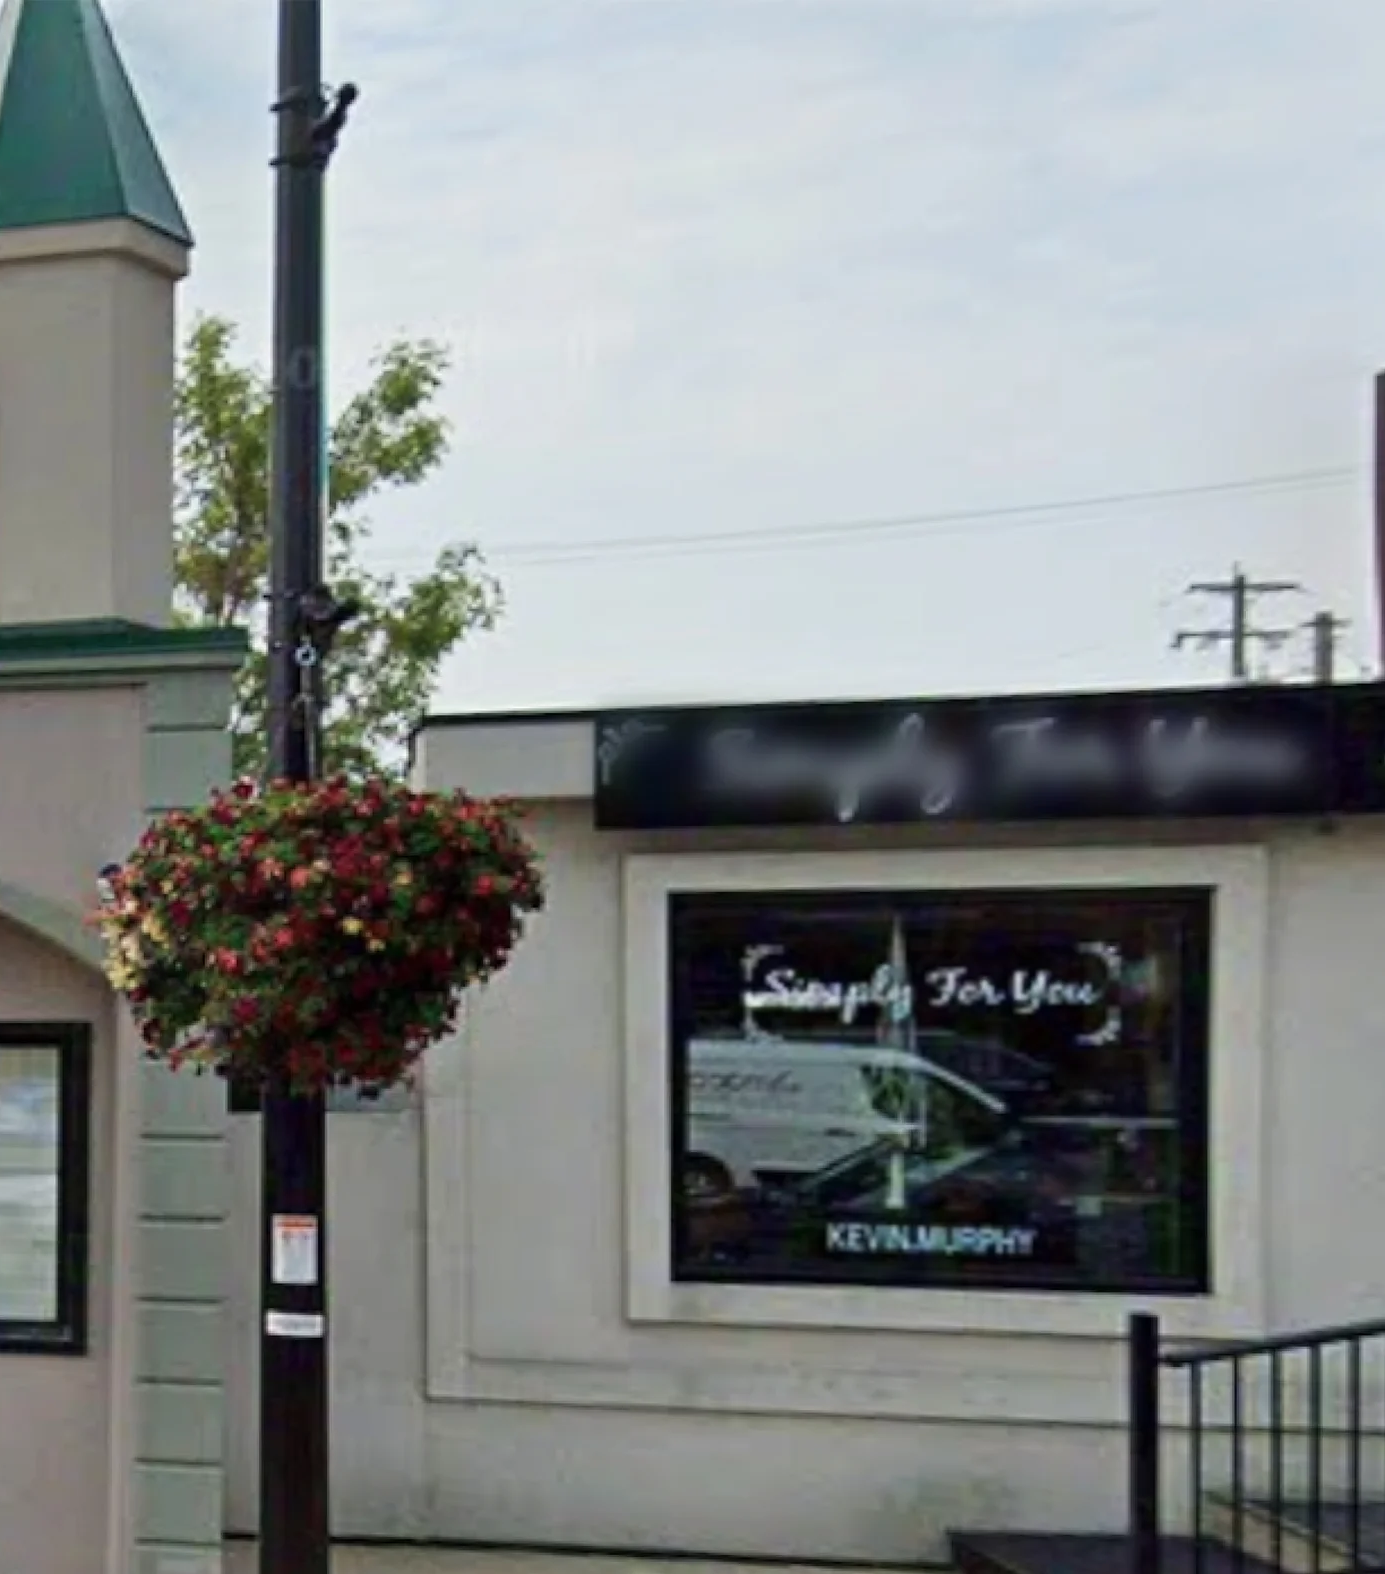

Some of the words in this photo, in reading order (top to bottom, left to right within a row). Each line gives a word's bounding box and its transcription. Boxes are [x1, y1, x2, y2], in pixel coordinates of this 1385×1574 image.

[760, 964, 913, 1024] Simply
[925, 966, 1006, 1006] For
[1011, 968, 1105, 1014] You
